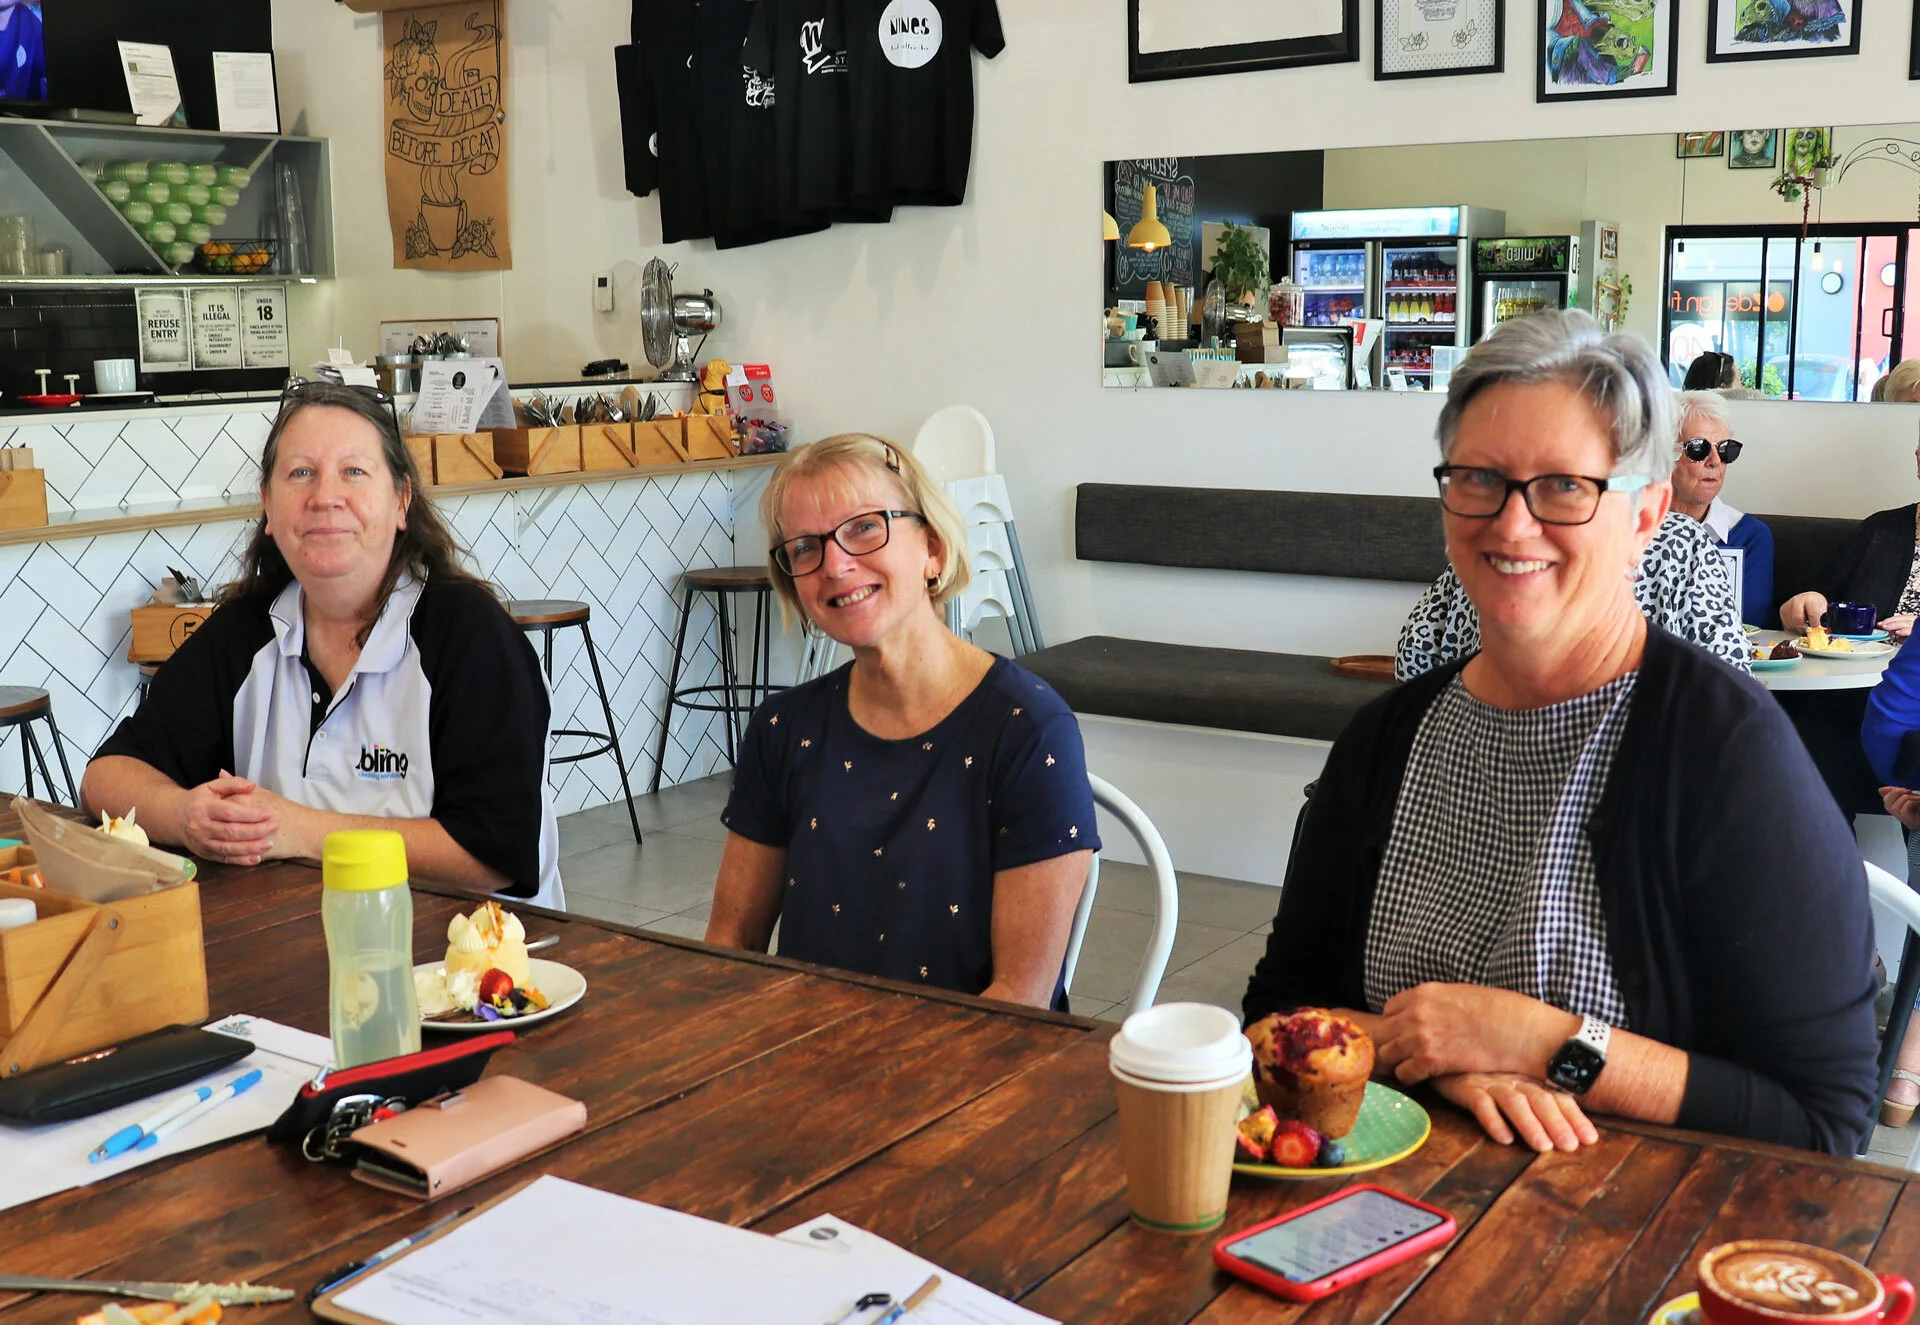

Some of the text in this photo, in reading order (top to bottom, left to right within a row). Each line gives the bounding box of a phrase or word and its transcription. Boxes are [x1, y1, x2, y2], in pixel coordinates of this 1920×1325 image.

[438, 82, 493, 114] DEATH
[391, 126, 495, 164] BEFORE DECAF
[208, 304, 224, 312] IT IS
[257, 305, 273, 321] 18
[203, 312, 231, 320] ILLEGAL
[148, 319, 180, 328] REFUSE
[150, 329, 178, 339] ENTRY
[355, 744, 409, 780] bling
